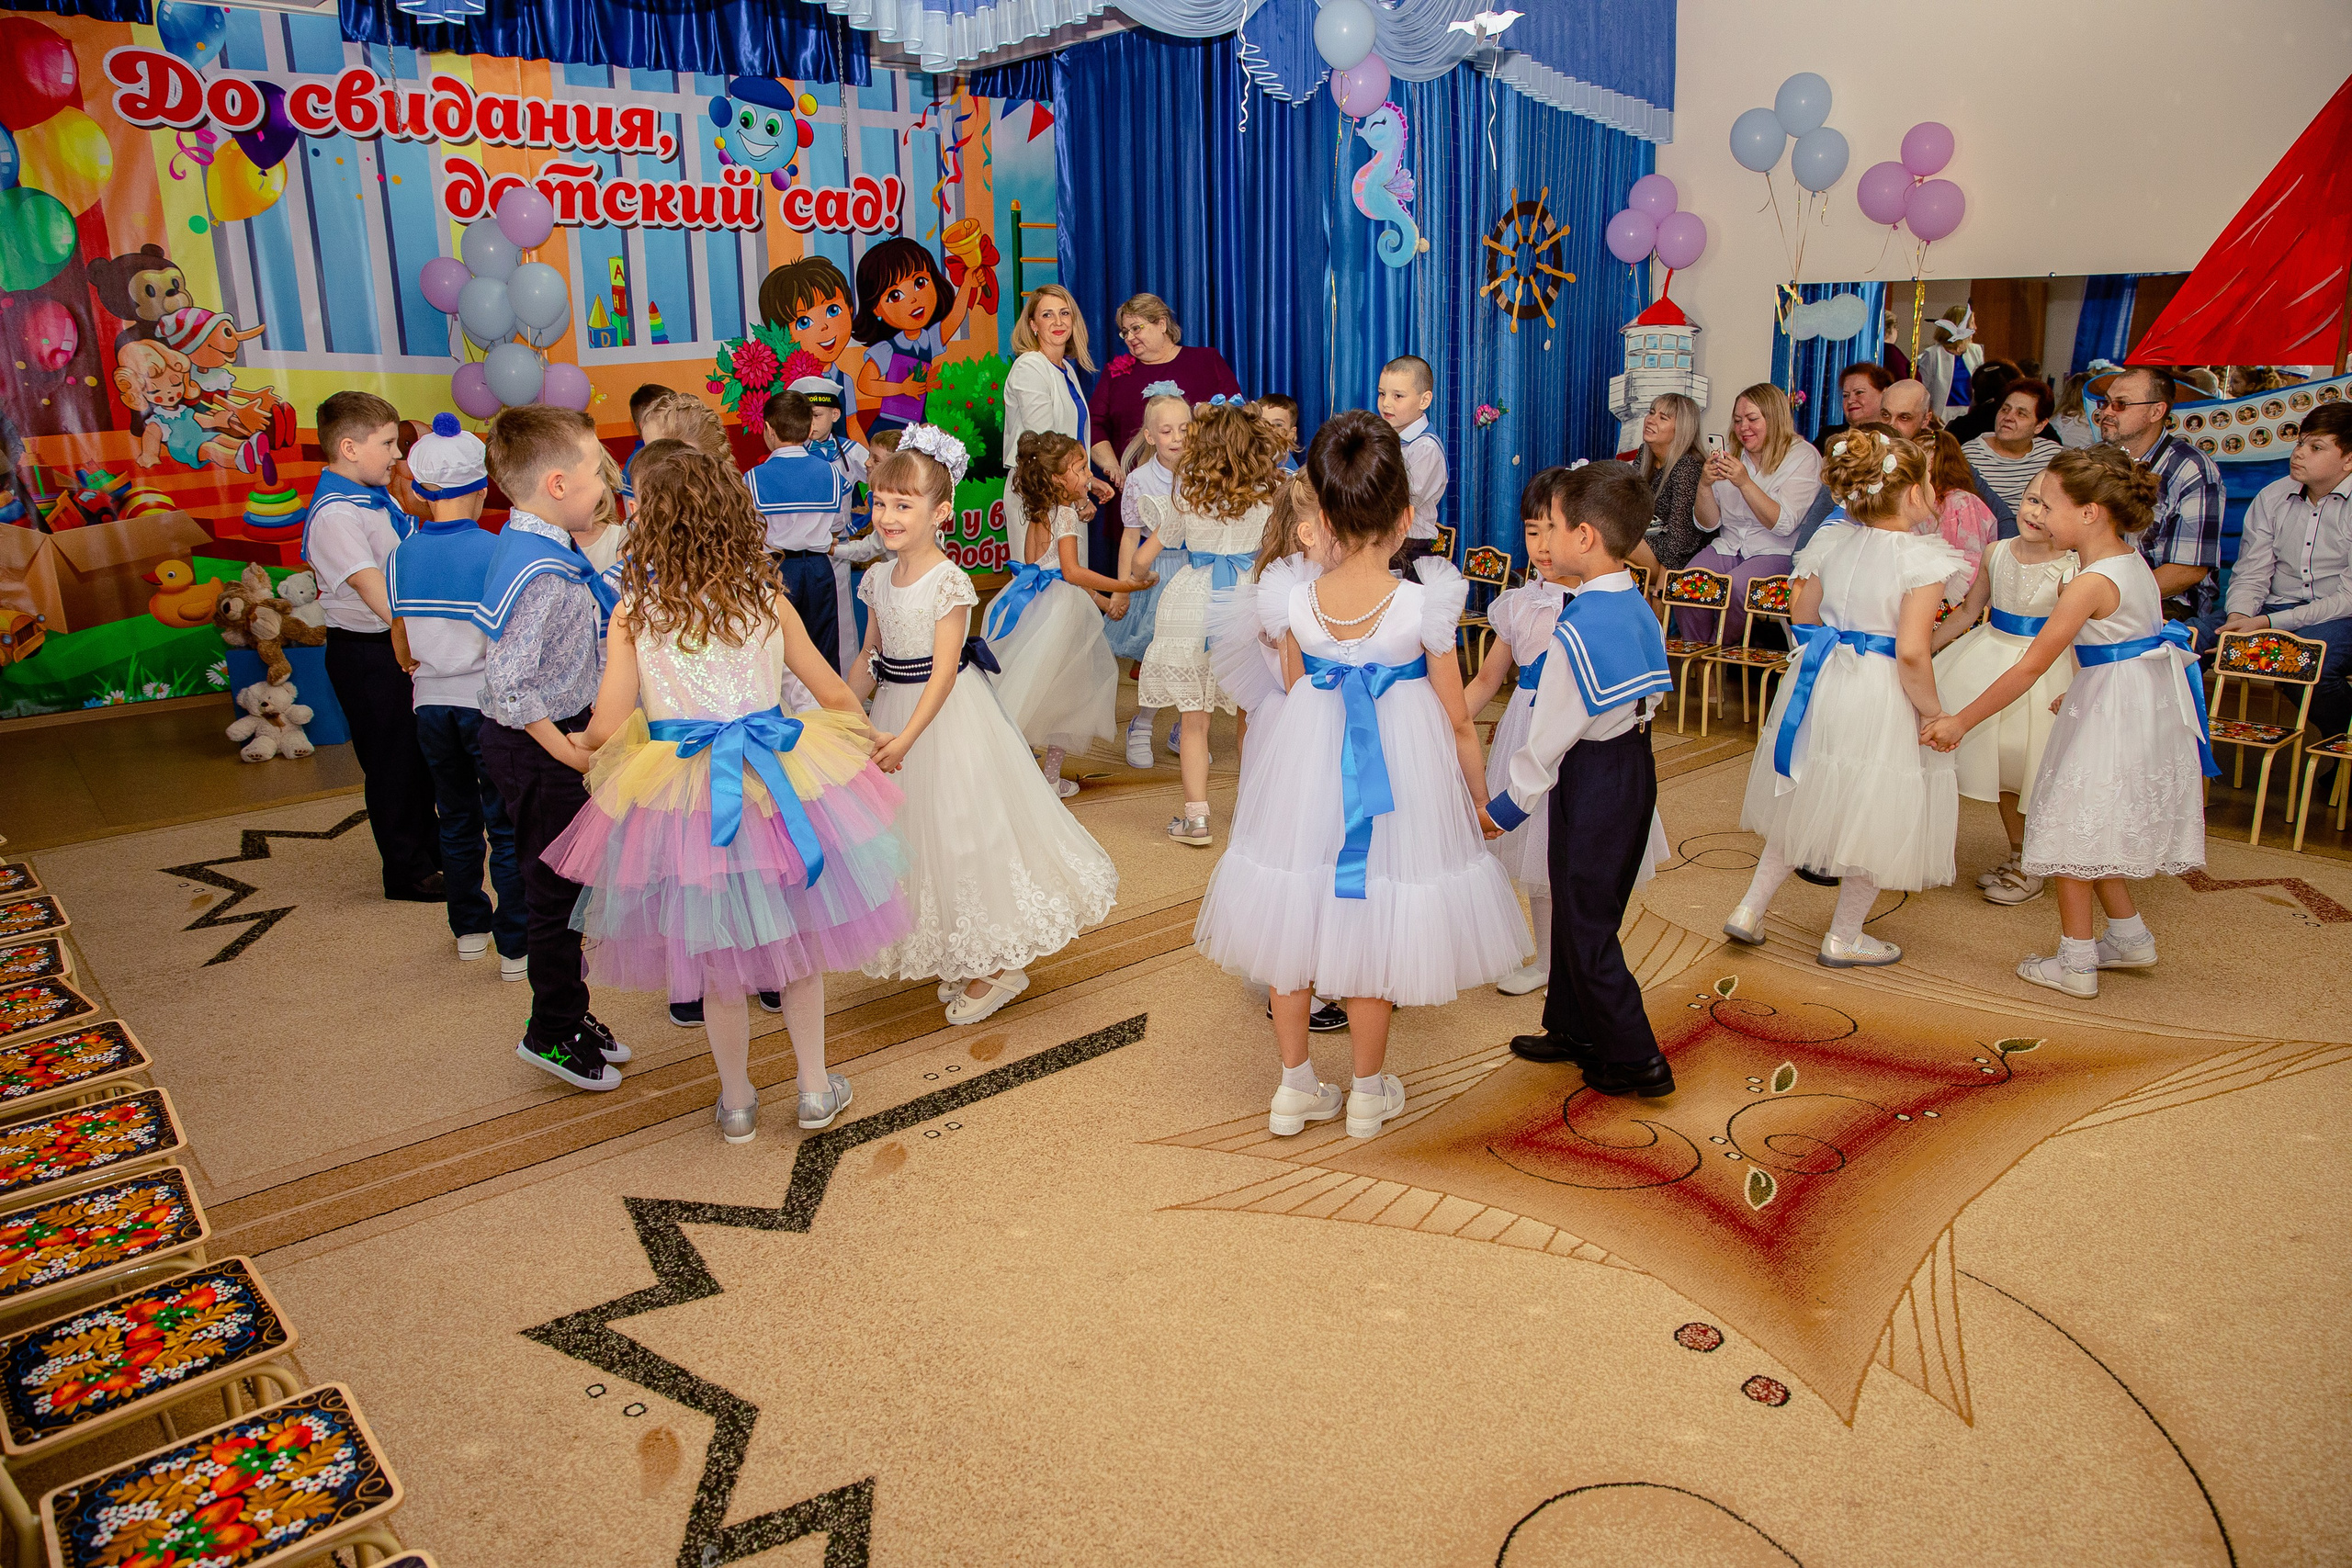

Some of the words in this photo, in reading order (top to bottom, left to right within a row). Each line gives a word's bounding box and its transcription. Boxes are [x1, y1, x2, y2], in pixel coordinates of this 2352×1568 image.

[107, 49, 262, 129] До
[287, 67, 676, 157] свидания,
[781, 176, 902, 231] сад!
